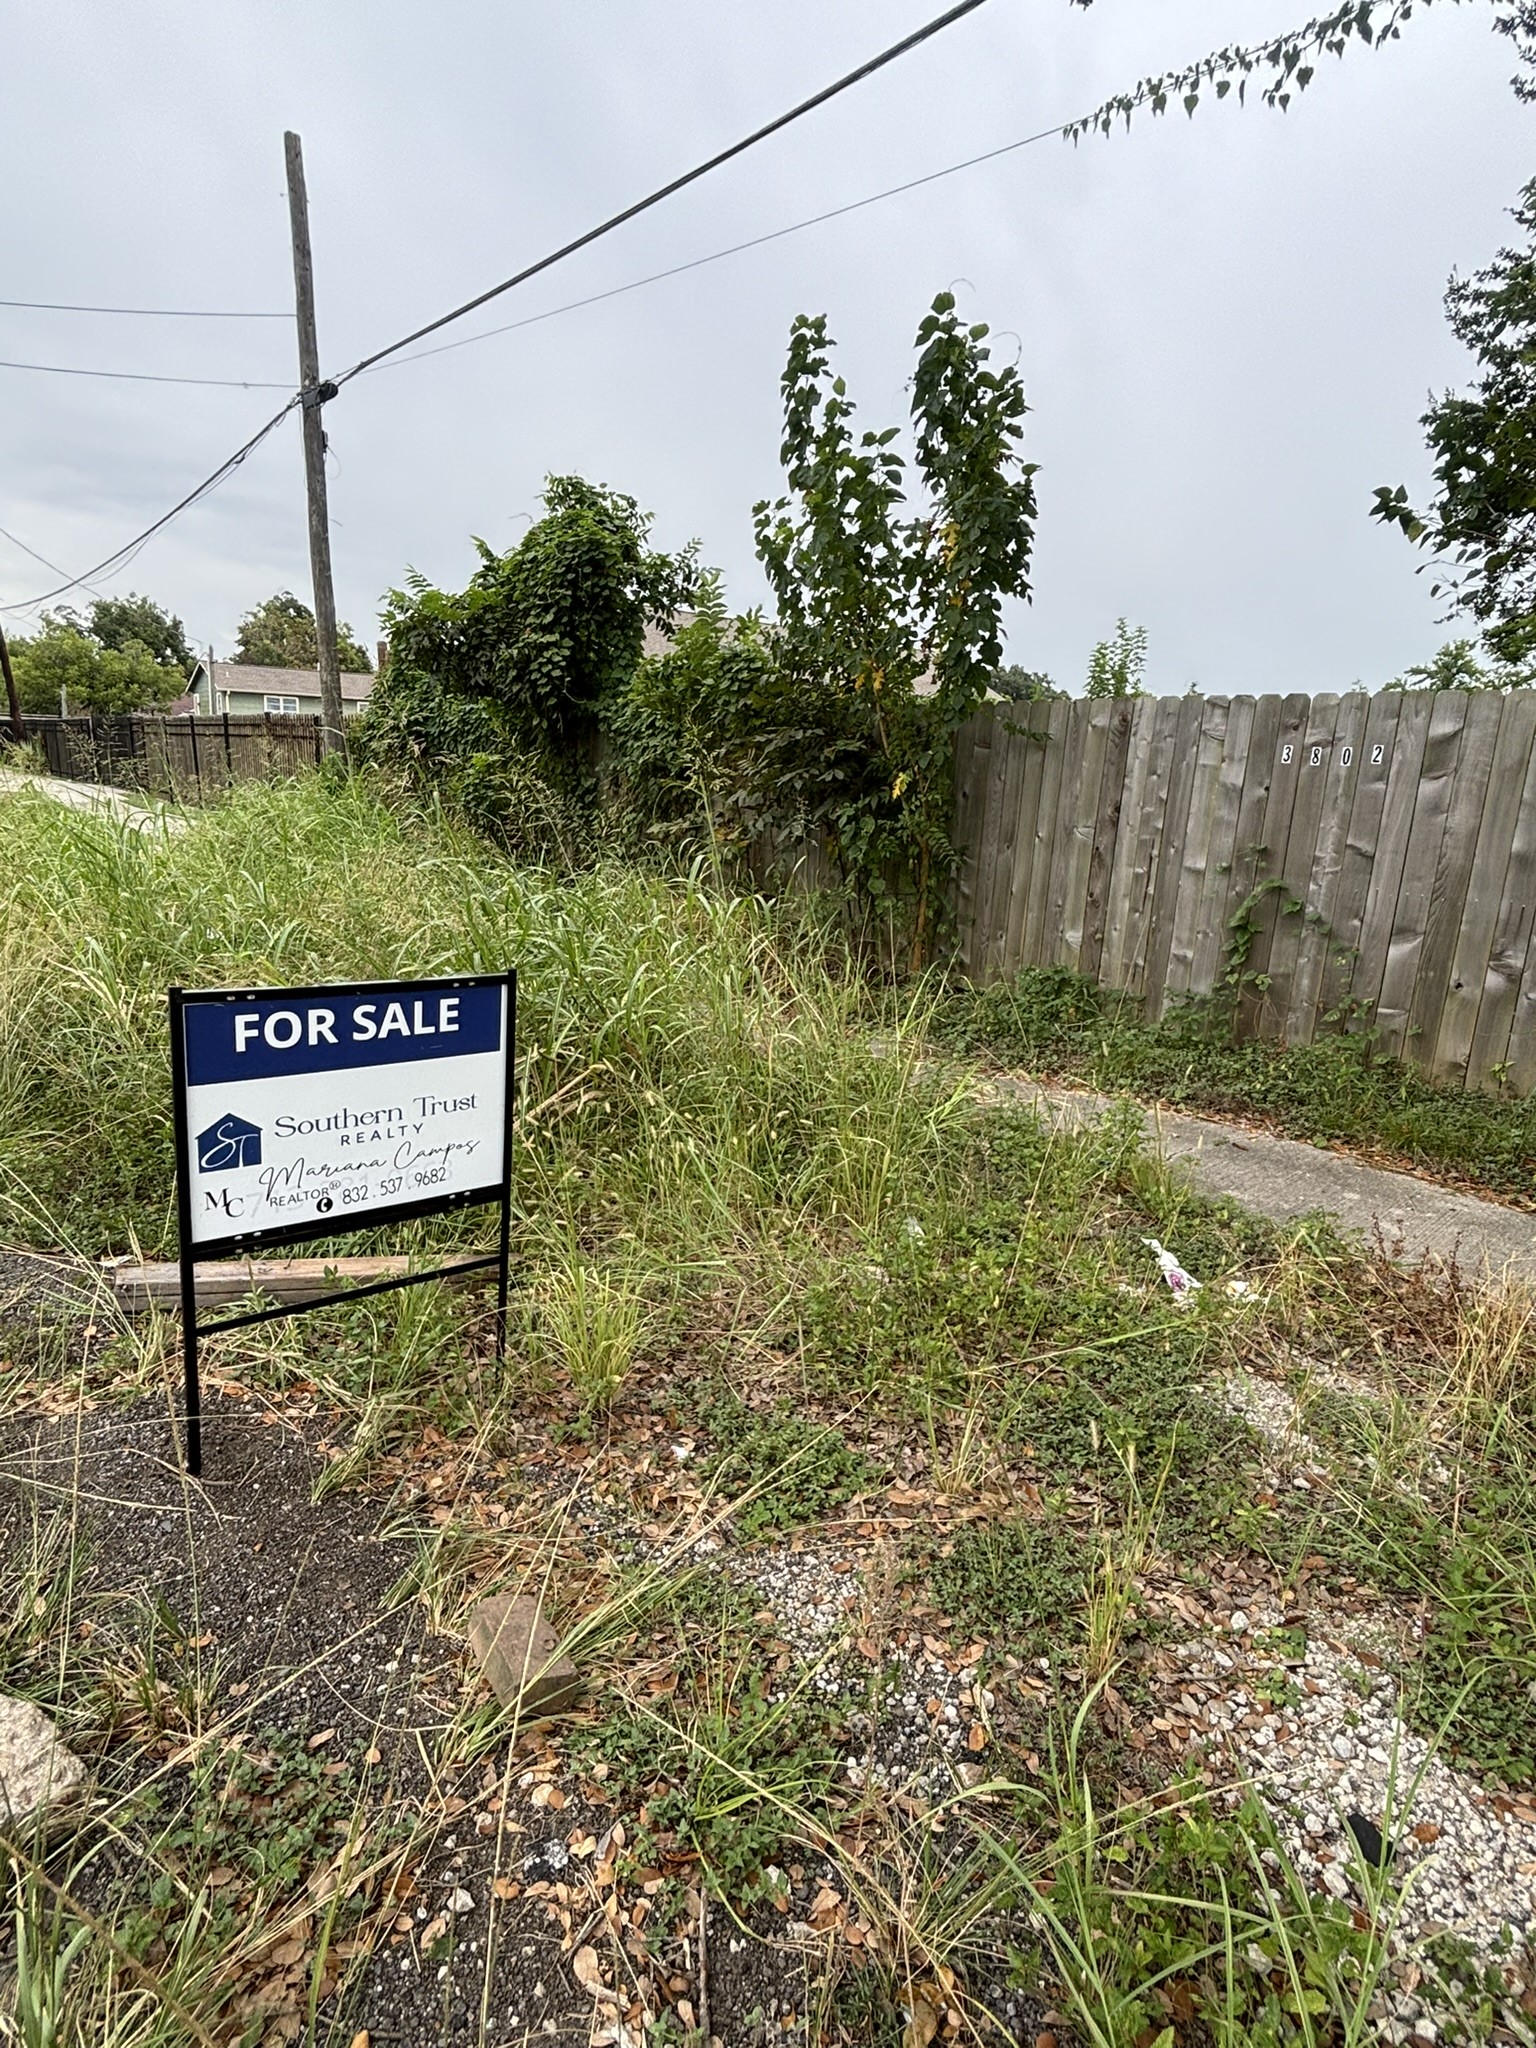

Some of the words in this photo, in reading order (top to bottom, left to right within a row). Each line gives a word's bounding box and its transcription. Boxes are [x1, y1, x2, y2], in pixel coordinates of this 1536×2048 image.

[1282, 745, 1383, 765] 3802
[234, 1008, 339, 1053] FOR
[352, 997, 460, 1041] SALE
[274, 1107, 403, 1138] Southern
[413, 1093, 478, 1117] Trust
[340, 1123, 423, 1146] REALTY
[258, 1157, 387, 1202] Mariana
[393, 1140, 481, 1170] Campos
